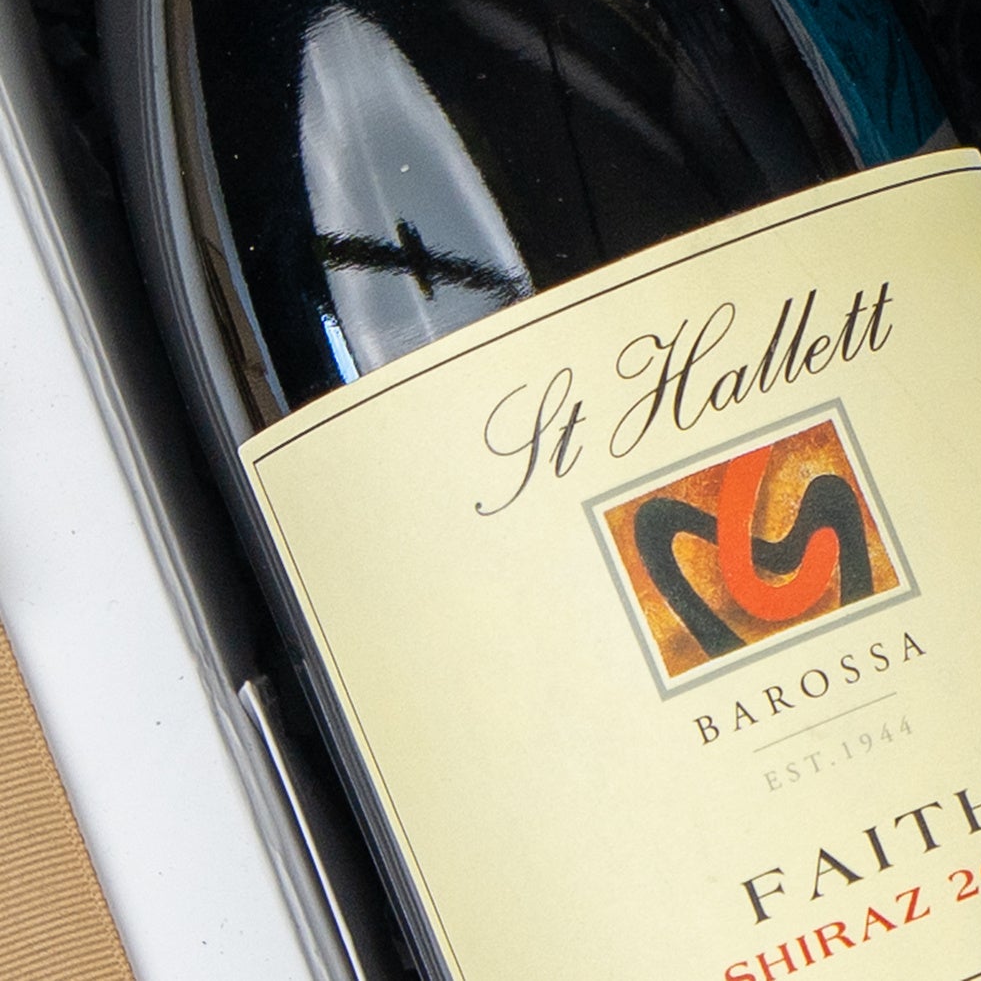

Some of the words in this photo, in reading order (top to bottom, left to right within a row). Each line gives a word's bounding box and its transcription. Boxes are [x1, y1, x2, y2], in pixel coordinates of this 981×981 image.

[474, 367, 587, 517] St
[610, 282, 893, 459] Hallett
[693, 631, 927, 745] BAROSSA
